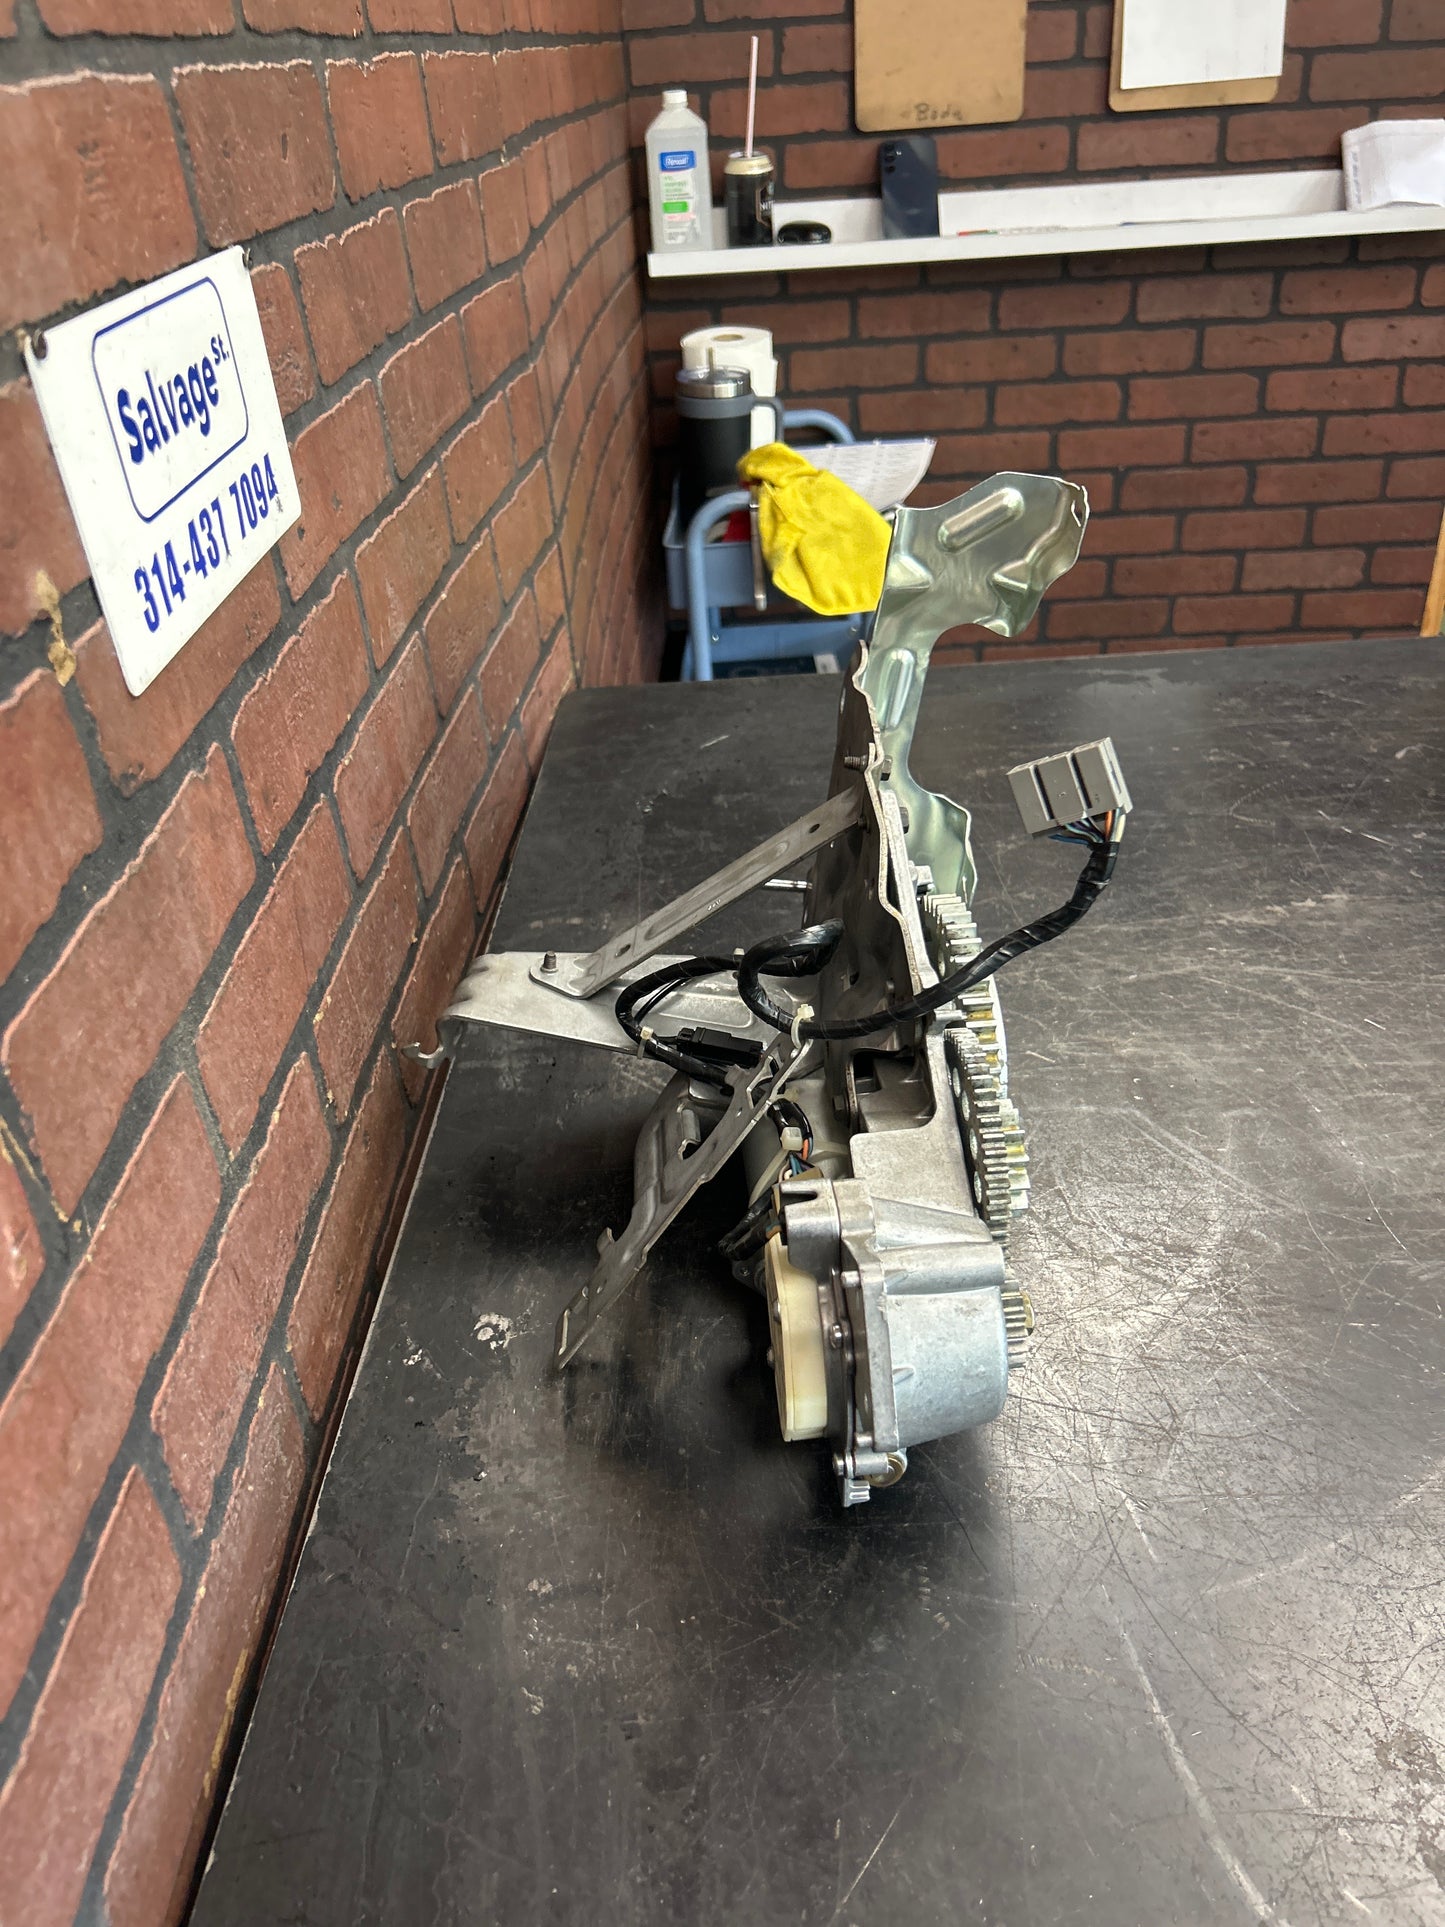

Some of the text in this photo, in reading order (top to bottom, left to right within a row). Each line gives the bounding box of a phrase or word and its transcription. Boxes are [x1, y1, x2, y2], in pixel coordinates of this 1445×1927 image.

[117, 334, 230, 465] Salvage St.
[134, 453, 279, 633] 314-437 7094
